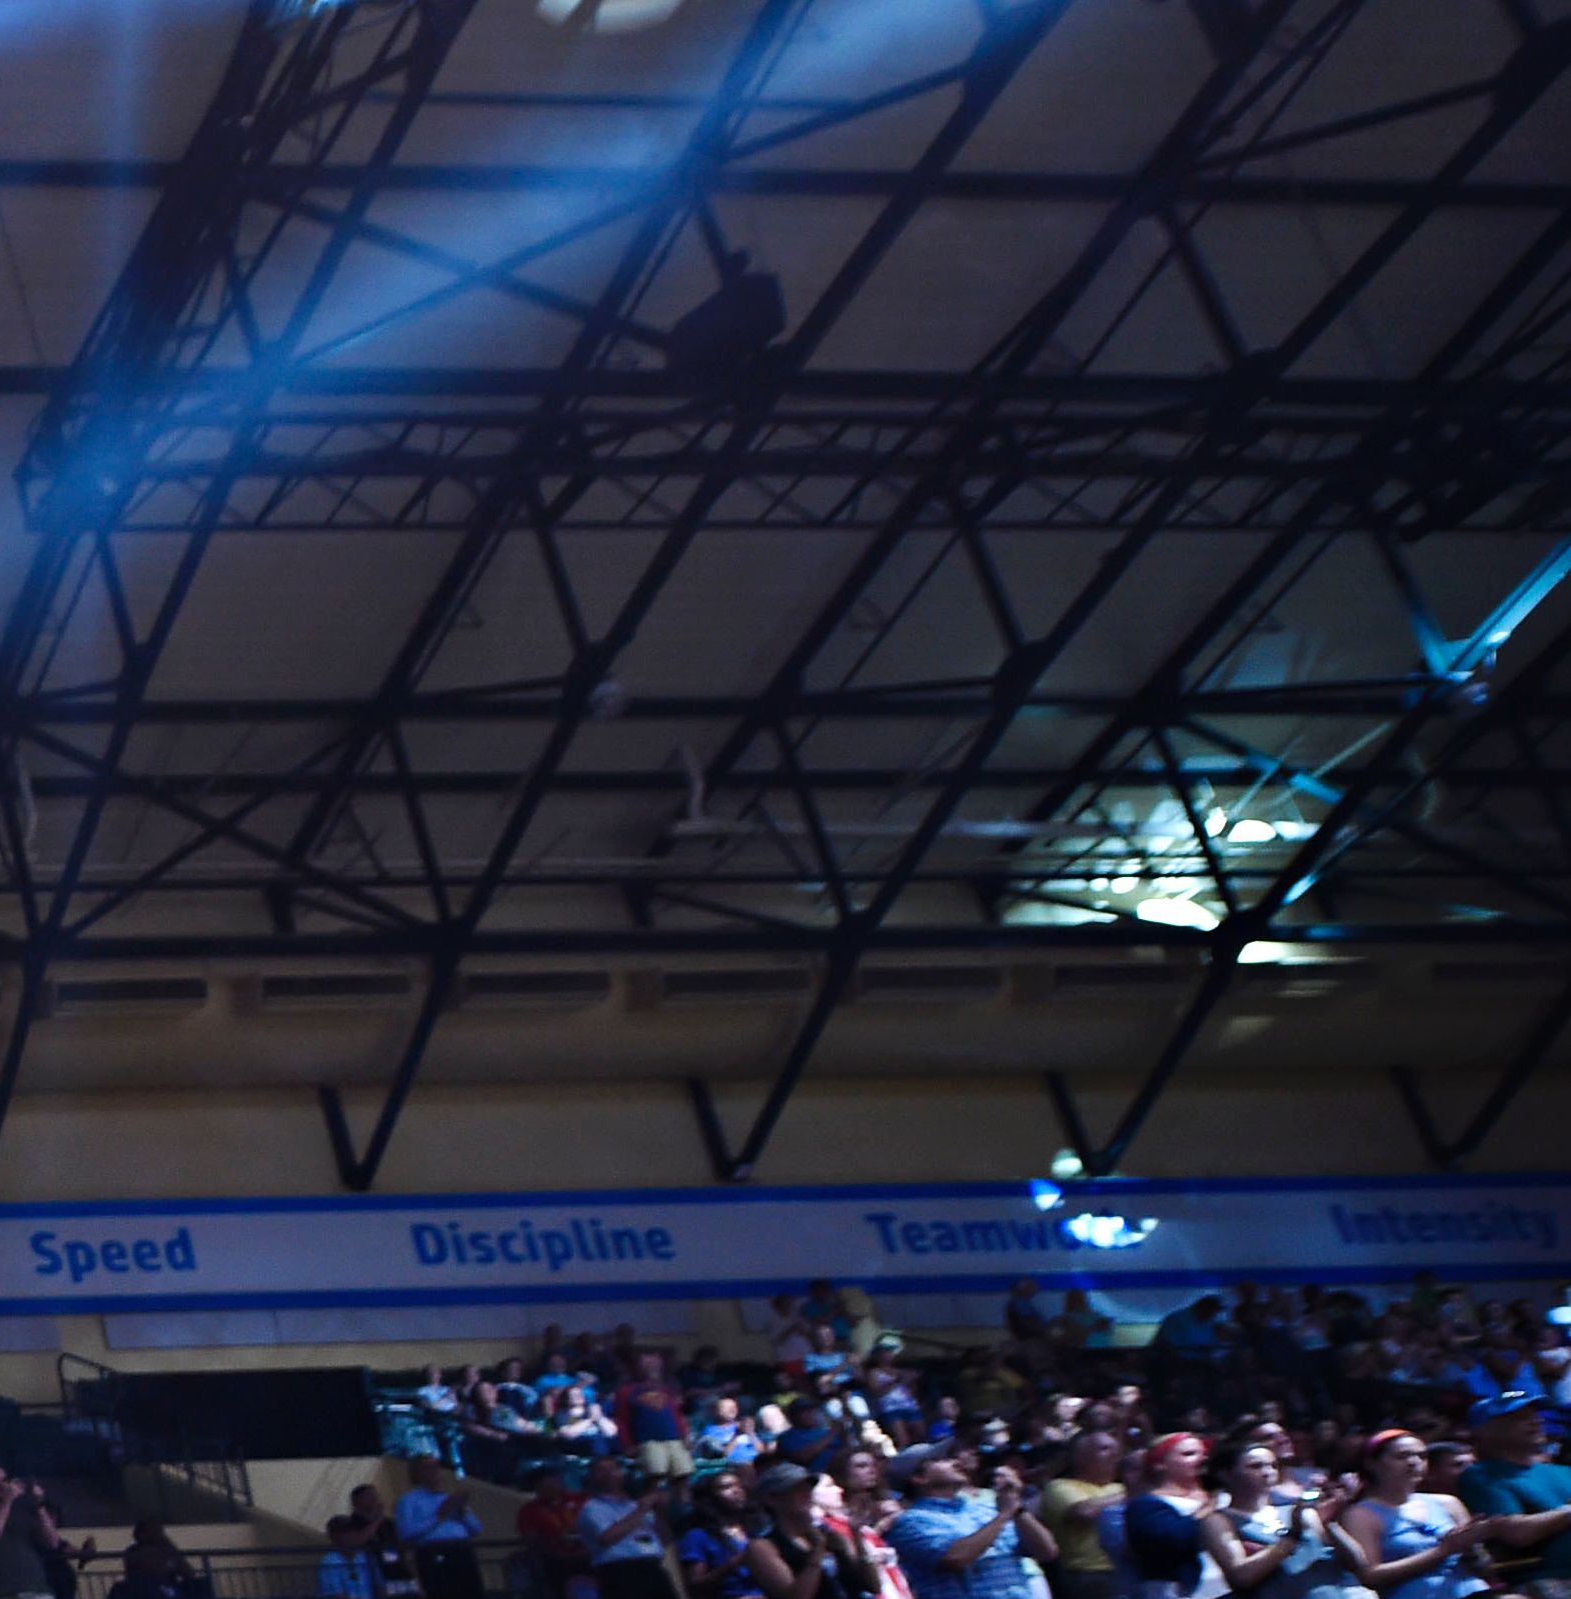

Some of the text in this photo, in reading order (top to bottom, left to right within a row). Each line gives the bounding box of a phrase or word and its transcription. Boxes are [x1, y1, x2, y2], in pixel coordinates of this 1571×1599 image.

[29, 1227, 196, 1284] Speed
[411, 1218, 677, 1271] Discipline
[863, 1208, 1142, 1254] Teamw
